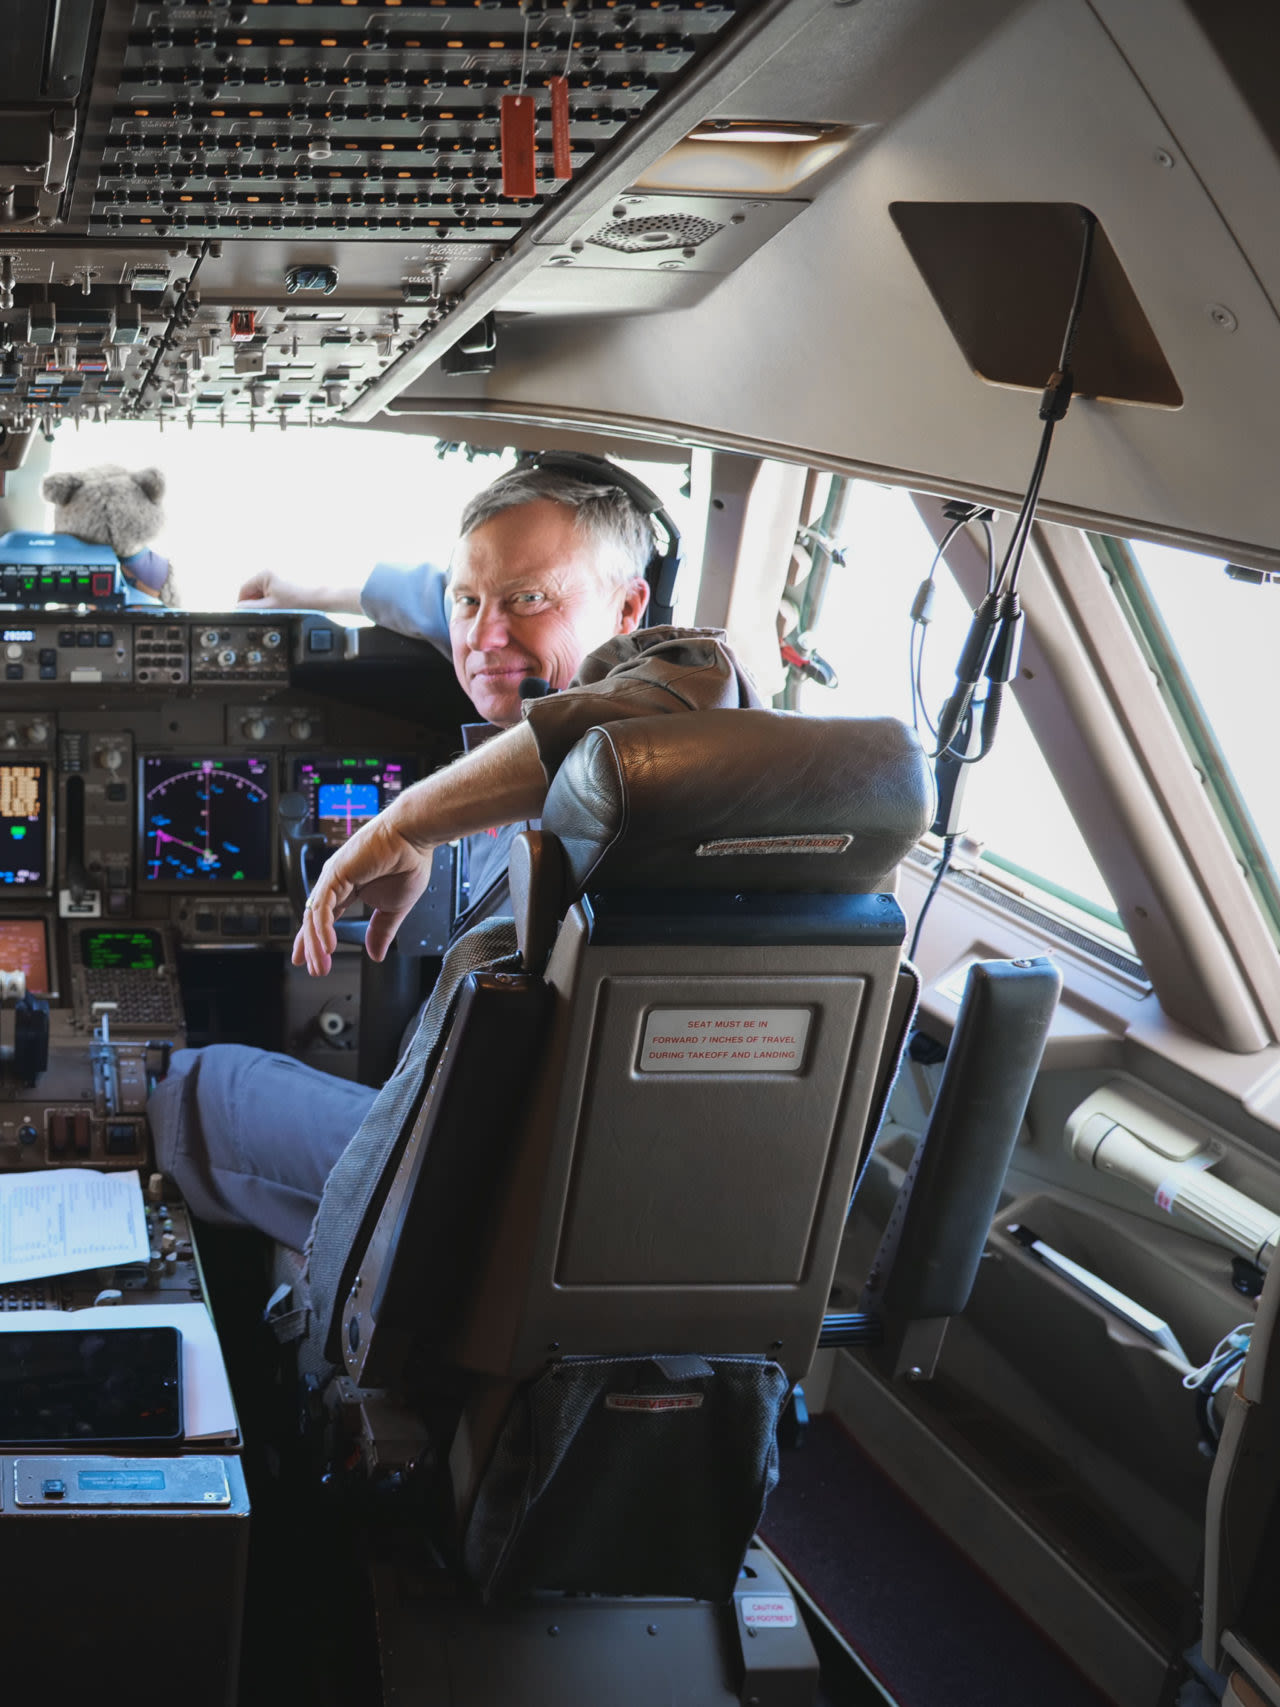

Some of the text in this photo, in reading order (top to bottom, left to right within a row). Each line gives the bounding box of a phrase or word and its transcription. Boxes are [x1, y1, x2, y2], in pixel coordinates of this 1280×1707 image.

[807, 839, 845, 847] ADJUST
[687, 1020, 768, 1029] SEAT MUST BE IN
[652, 1035, 795, 1044] FORWARD 7 INCHES OF TRAVEL
[649, 1051, 795, 1059] DURING TAKEOFF AND LANDING
[752, 1603, 784, 1611] CAUTION
